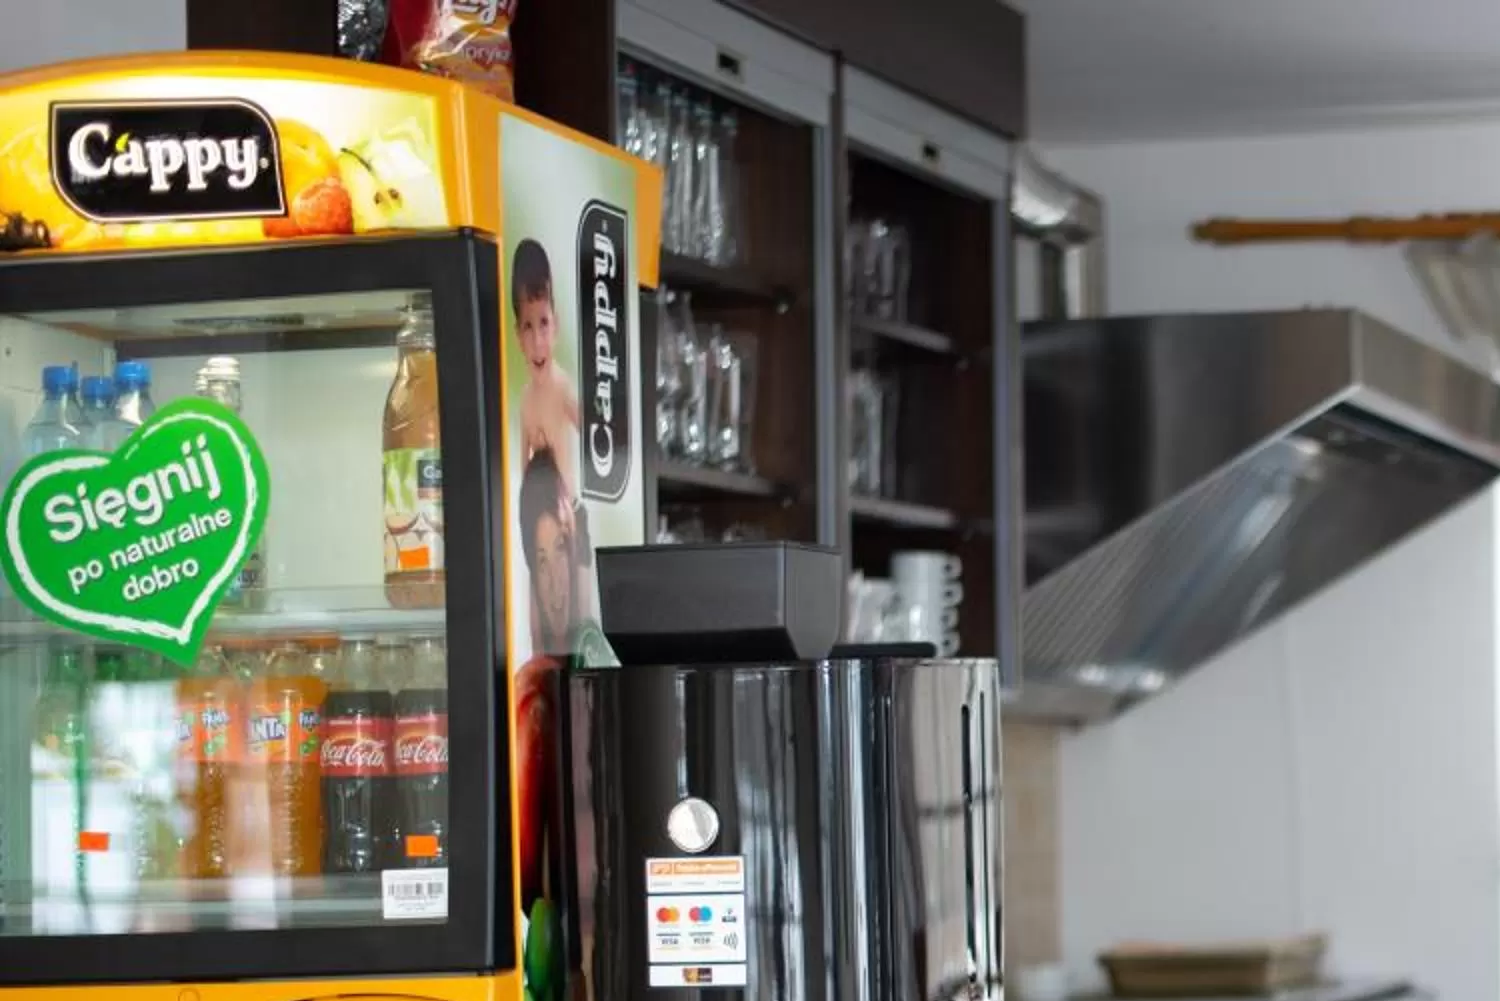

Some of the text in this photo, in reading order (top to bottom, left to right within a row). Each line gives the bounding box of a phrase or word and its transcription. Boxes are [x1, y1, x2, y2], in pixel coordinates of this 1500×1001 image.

[68, 121, 259, 192] Cappy
[590, 232, 619, 478] Cappy
[43, 432, 222, 543] Sięgnij
[66, 507, 232, 594] po naturalne
[122, 557, 200, 602] dobro
